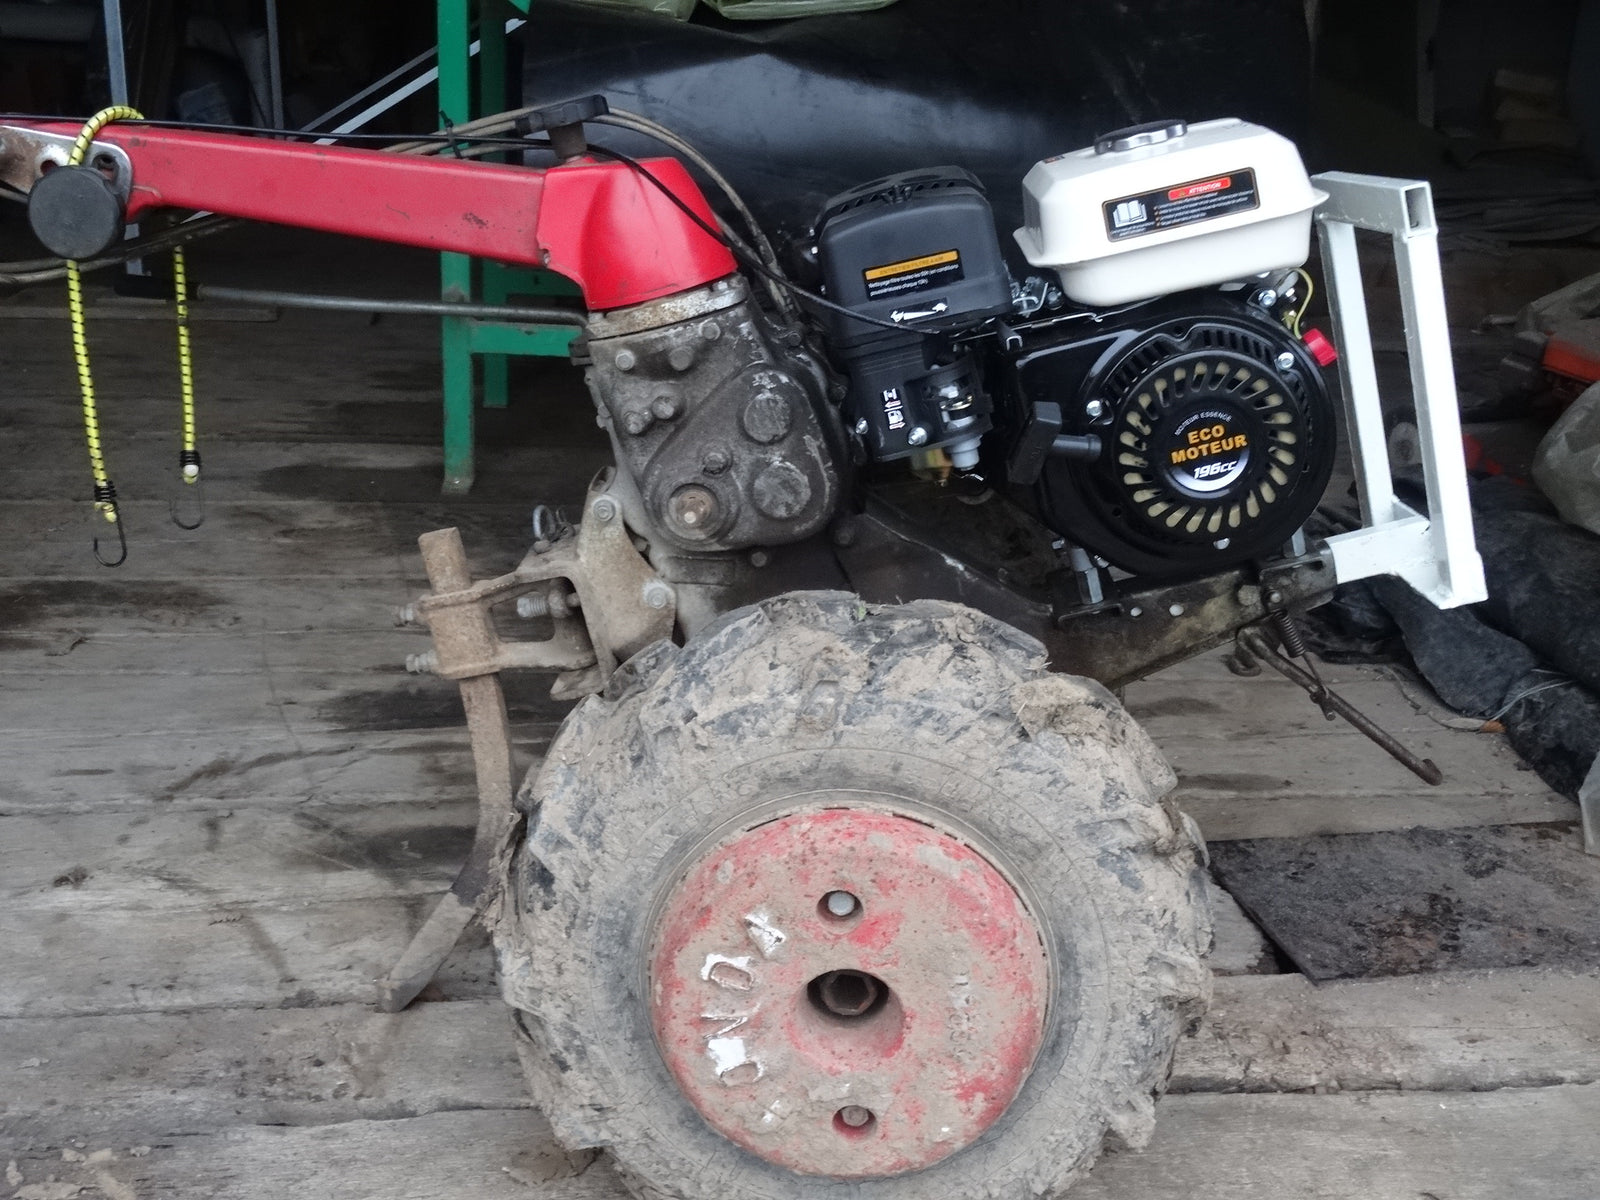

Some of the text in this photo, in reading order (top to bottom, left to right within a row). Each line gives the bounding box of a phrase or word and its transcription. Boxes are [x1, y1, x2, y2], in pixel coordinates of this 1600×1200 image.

[1200, 411, 1233, 423] ESSENCE
[1187, 424, 1225, 444] ECO
[1171, 434, 1248, 464] MOTEUR
[1193, 461, 1237, 480] 196cc
